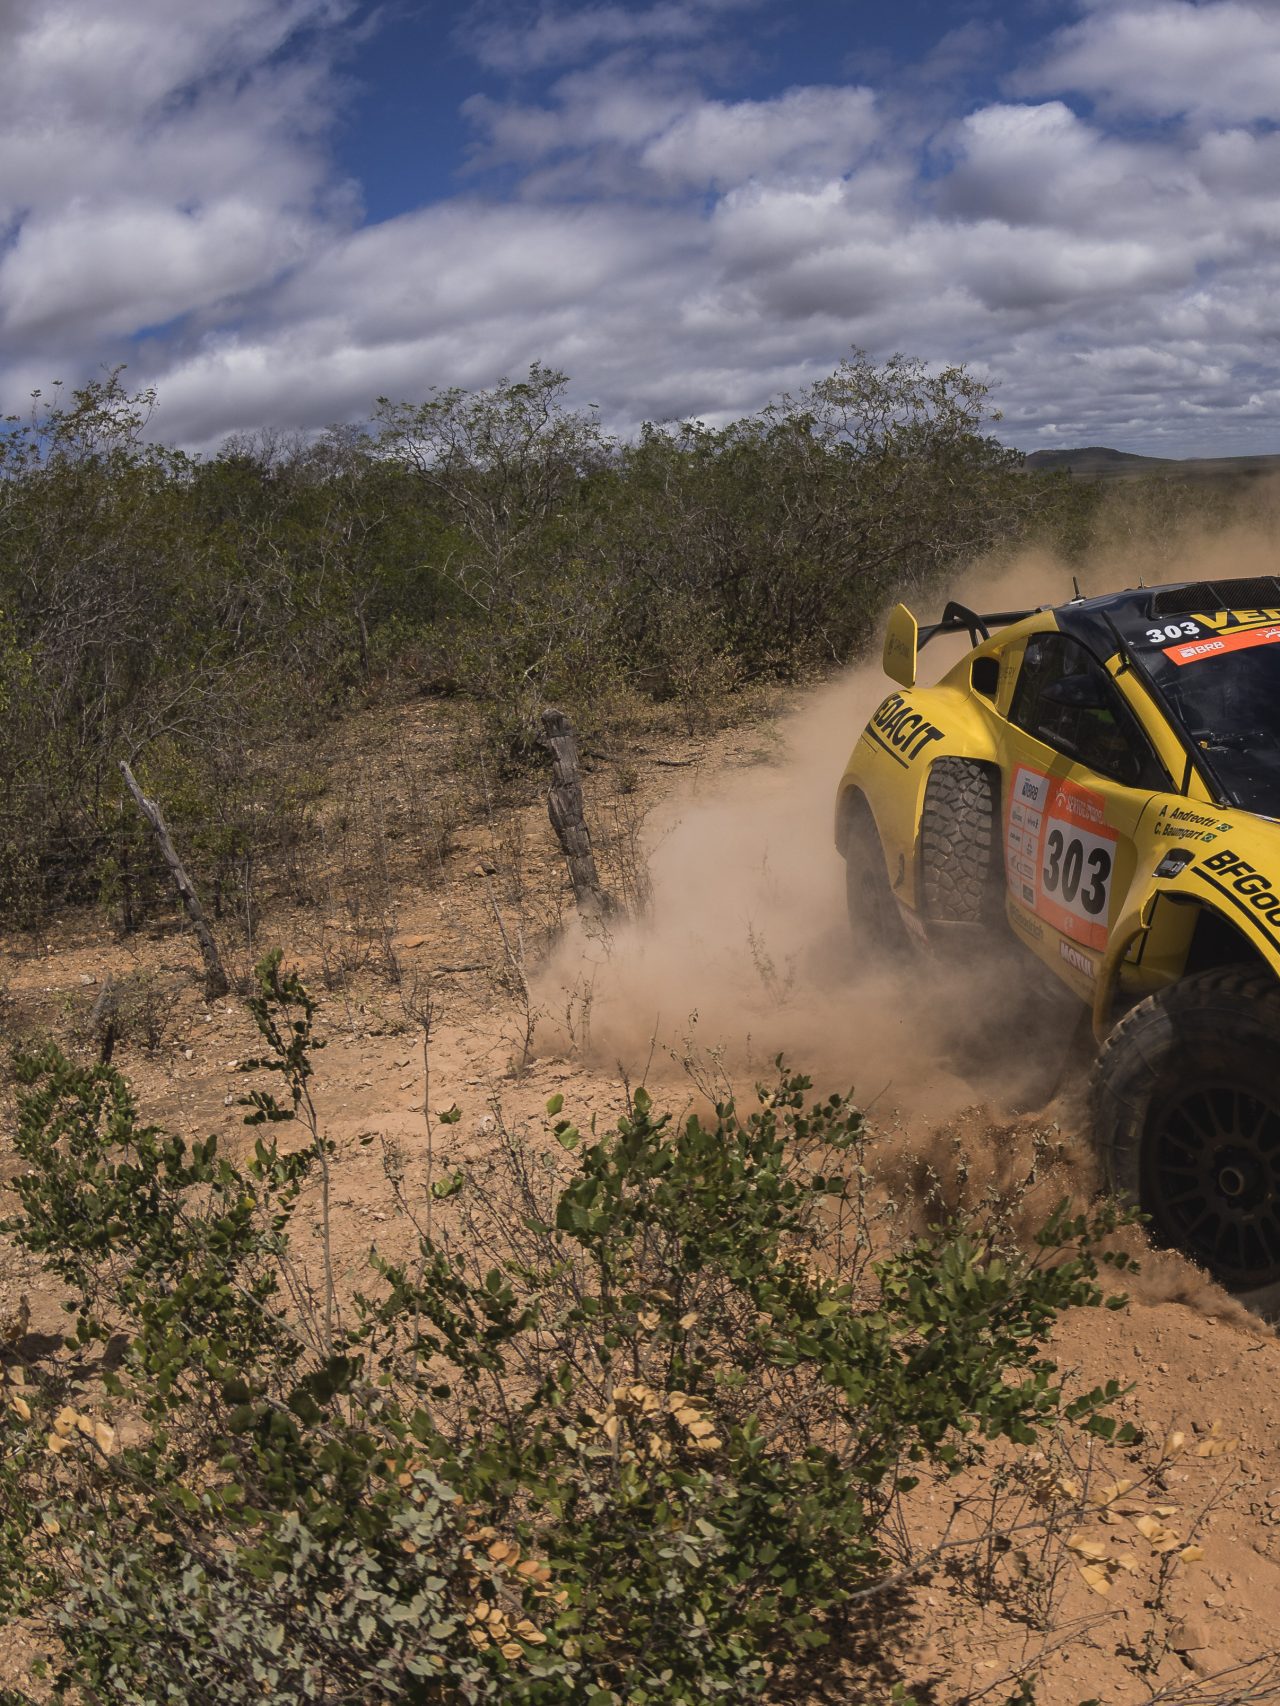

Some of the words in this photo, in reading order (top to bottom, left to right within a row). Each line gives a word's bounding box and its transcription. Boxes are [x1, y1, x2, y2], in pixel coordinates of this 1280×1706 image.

[1146, 621, 1200, 643] 303
[873, 693, 946, 761] EDACIT
[1162, 823, 1206, 840] Baumgart
[1169, 807, 1220, 828] Andreotti
[1043, 829, 1111, 914] 303
[1061, 941, 1094, 978] MOTUL
